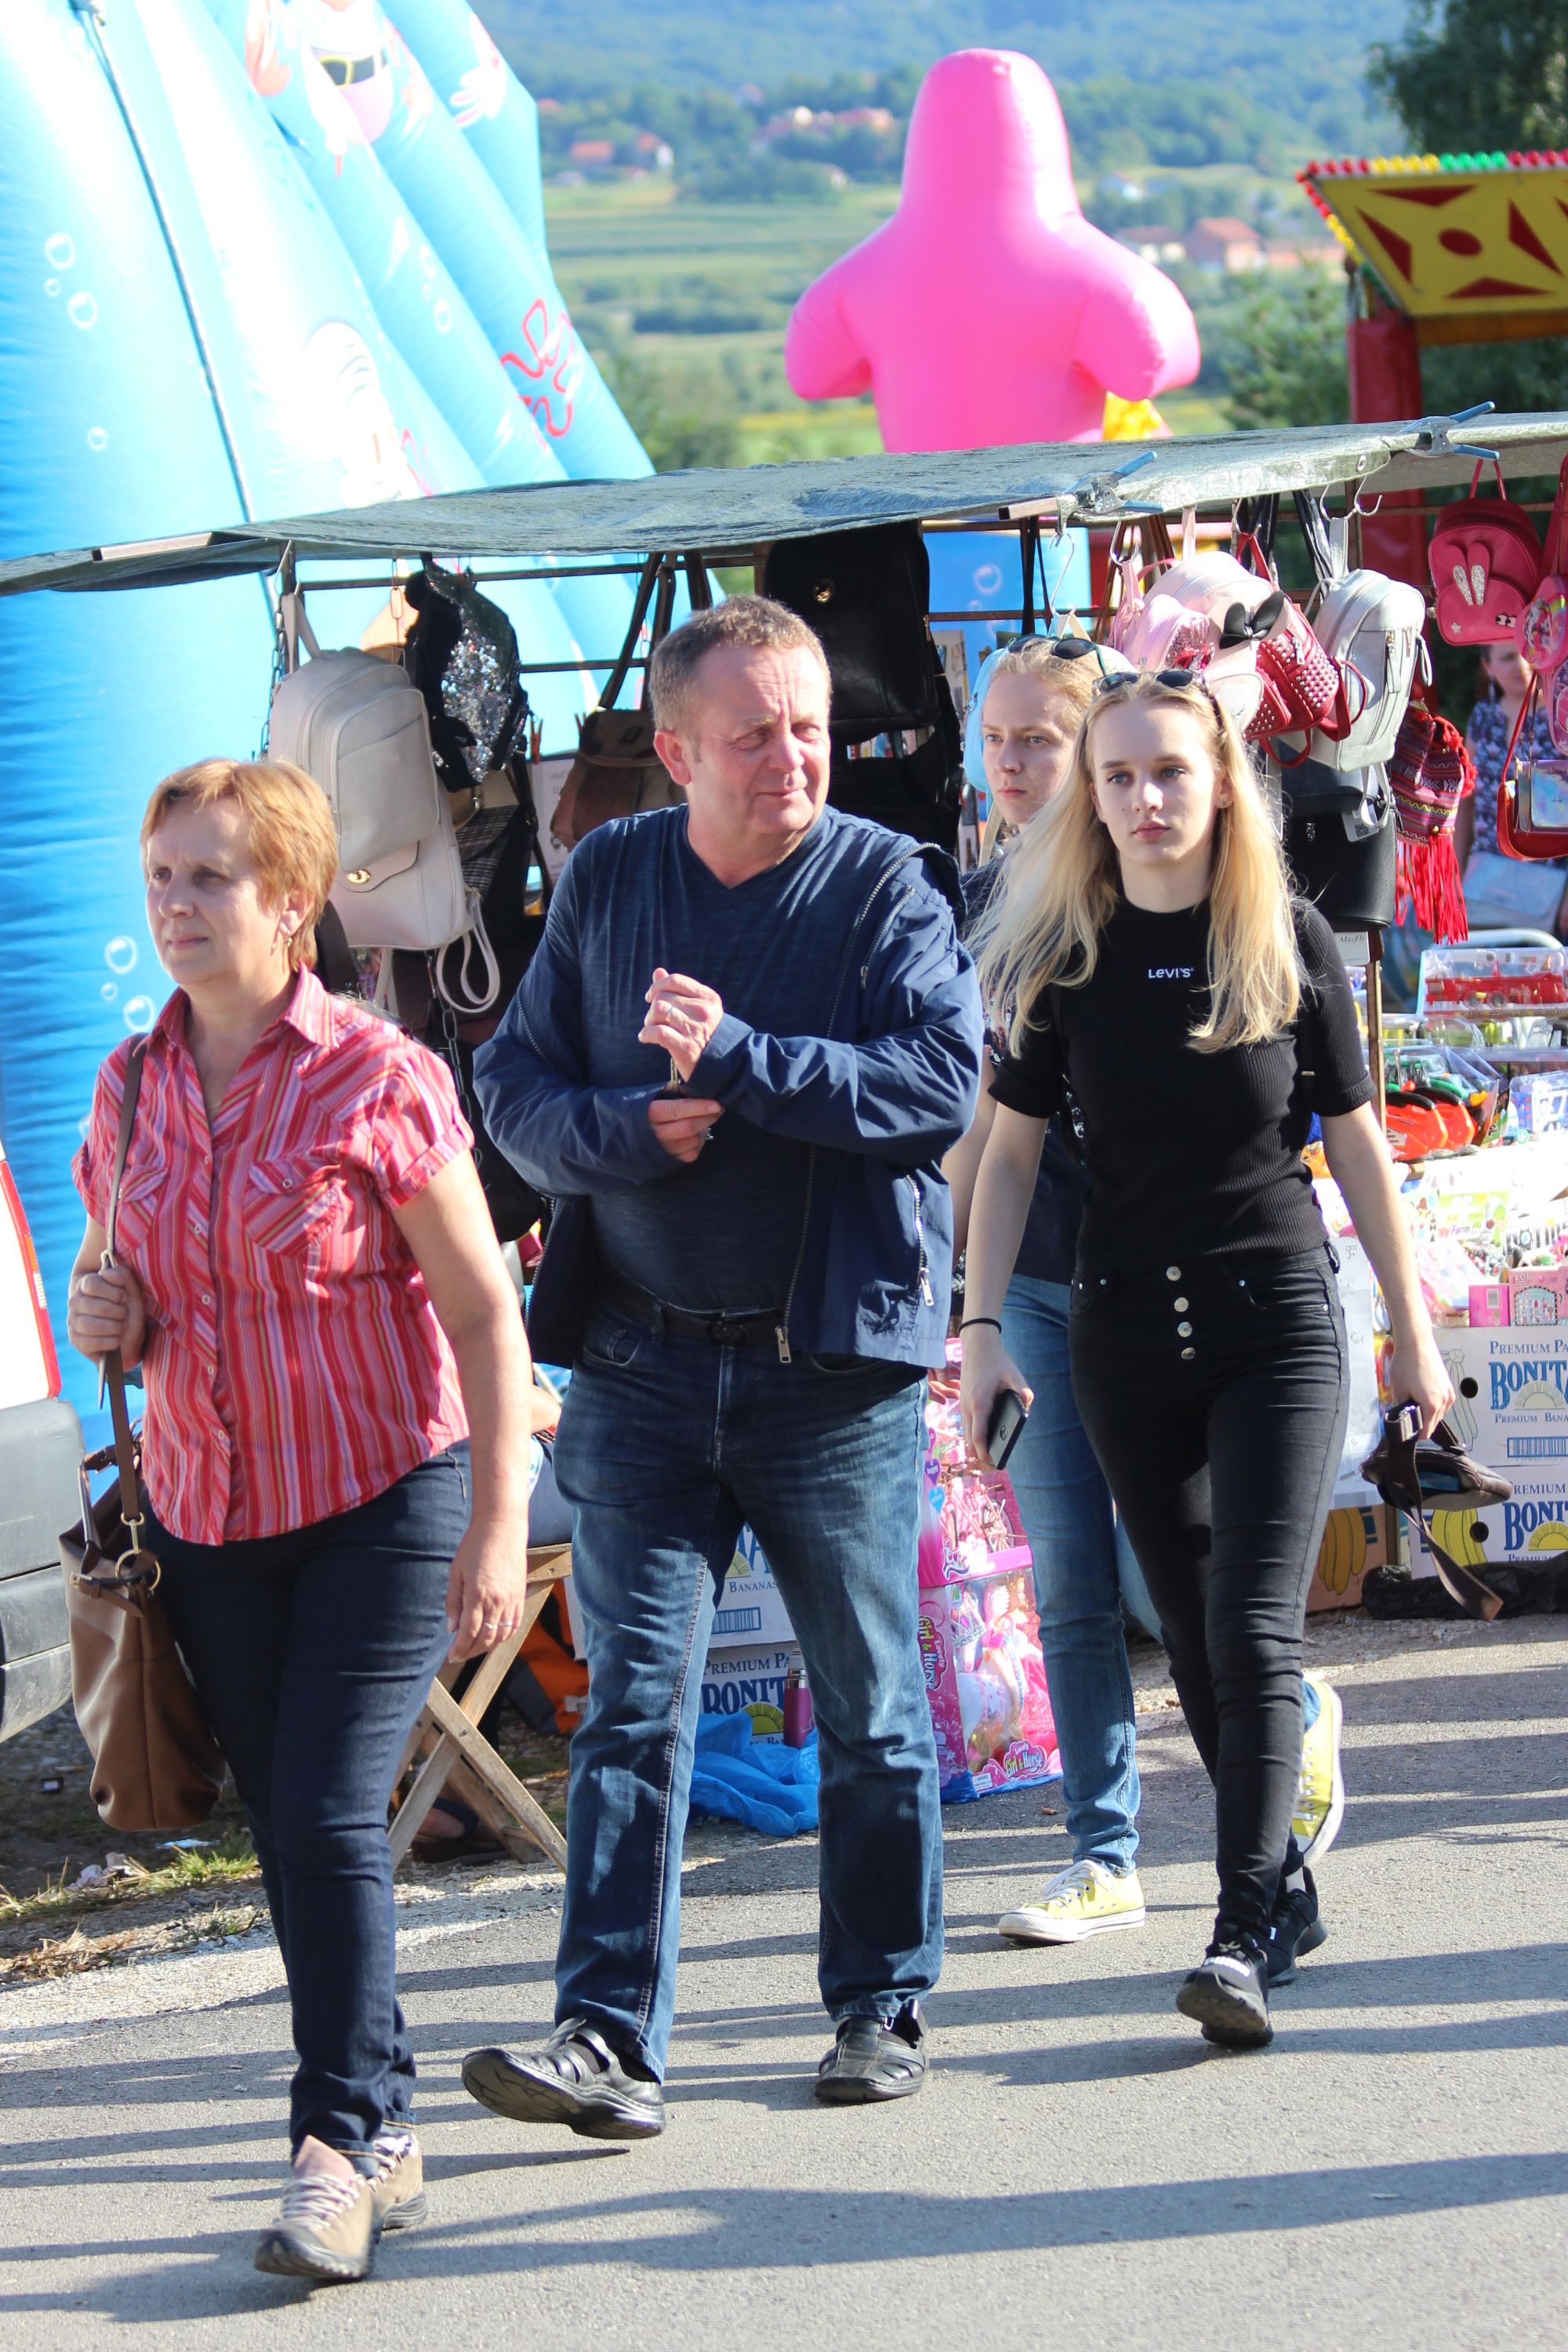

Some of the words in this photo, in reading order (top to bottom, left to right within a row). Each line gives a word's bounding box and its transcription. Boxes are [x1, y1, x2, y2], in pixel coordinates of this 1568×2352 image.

[1451, 1224, 1470, 1236] Farm
[1490, 1341, 1550, 1355] PREMIUM
[1489, 1359, 1568, 1410] BONIT
[1495, 1413, 1537, 1424] PREMIUM
[1510, 1482, 1566, 1495] REMIUM
[1502, 1501, 1568, 1551] BONI
[729, 1581, 779, 1593] BANANAS
[934, 1639, 946, 1668] Lovely
[924, 1652, 938, 1690] Horse
[1014, 1742, 1029, 1755] Lovely
[1005, 1755, 1018, 1778] Girl
[1022, 1751, 1044, 1769] Horse
